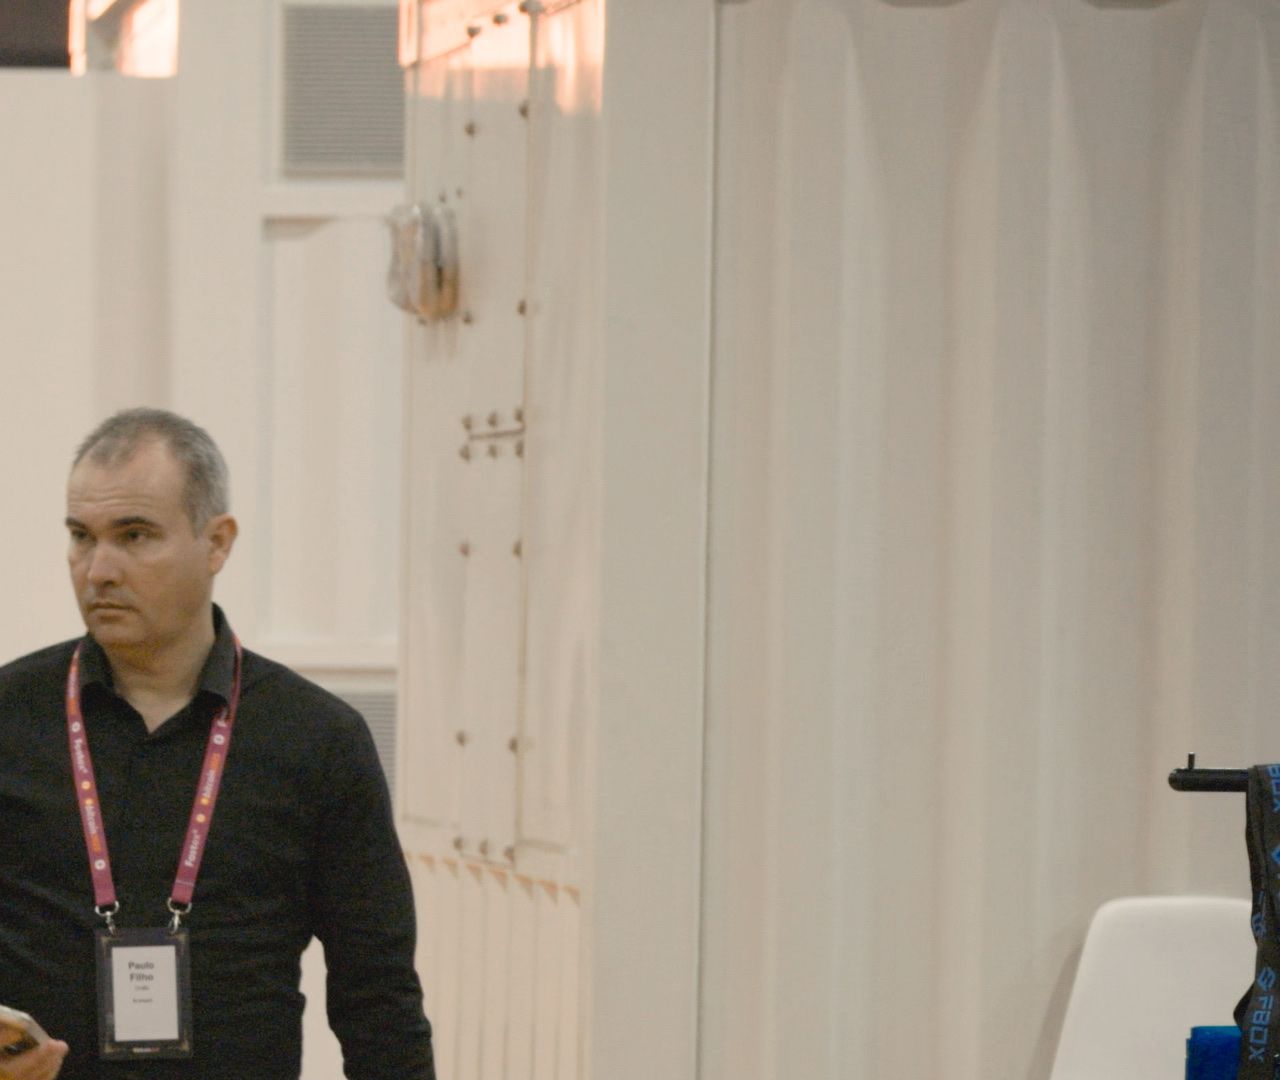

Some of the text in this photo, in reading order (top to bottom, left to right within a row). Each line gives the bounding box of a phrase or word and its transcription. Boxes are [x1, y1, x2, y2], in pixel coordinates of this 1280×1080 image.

[128, 961, 154, 970] Paulo
[129, 972, 154, 982] Filho
[1248, 996, 1273, 1062] FBOX
